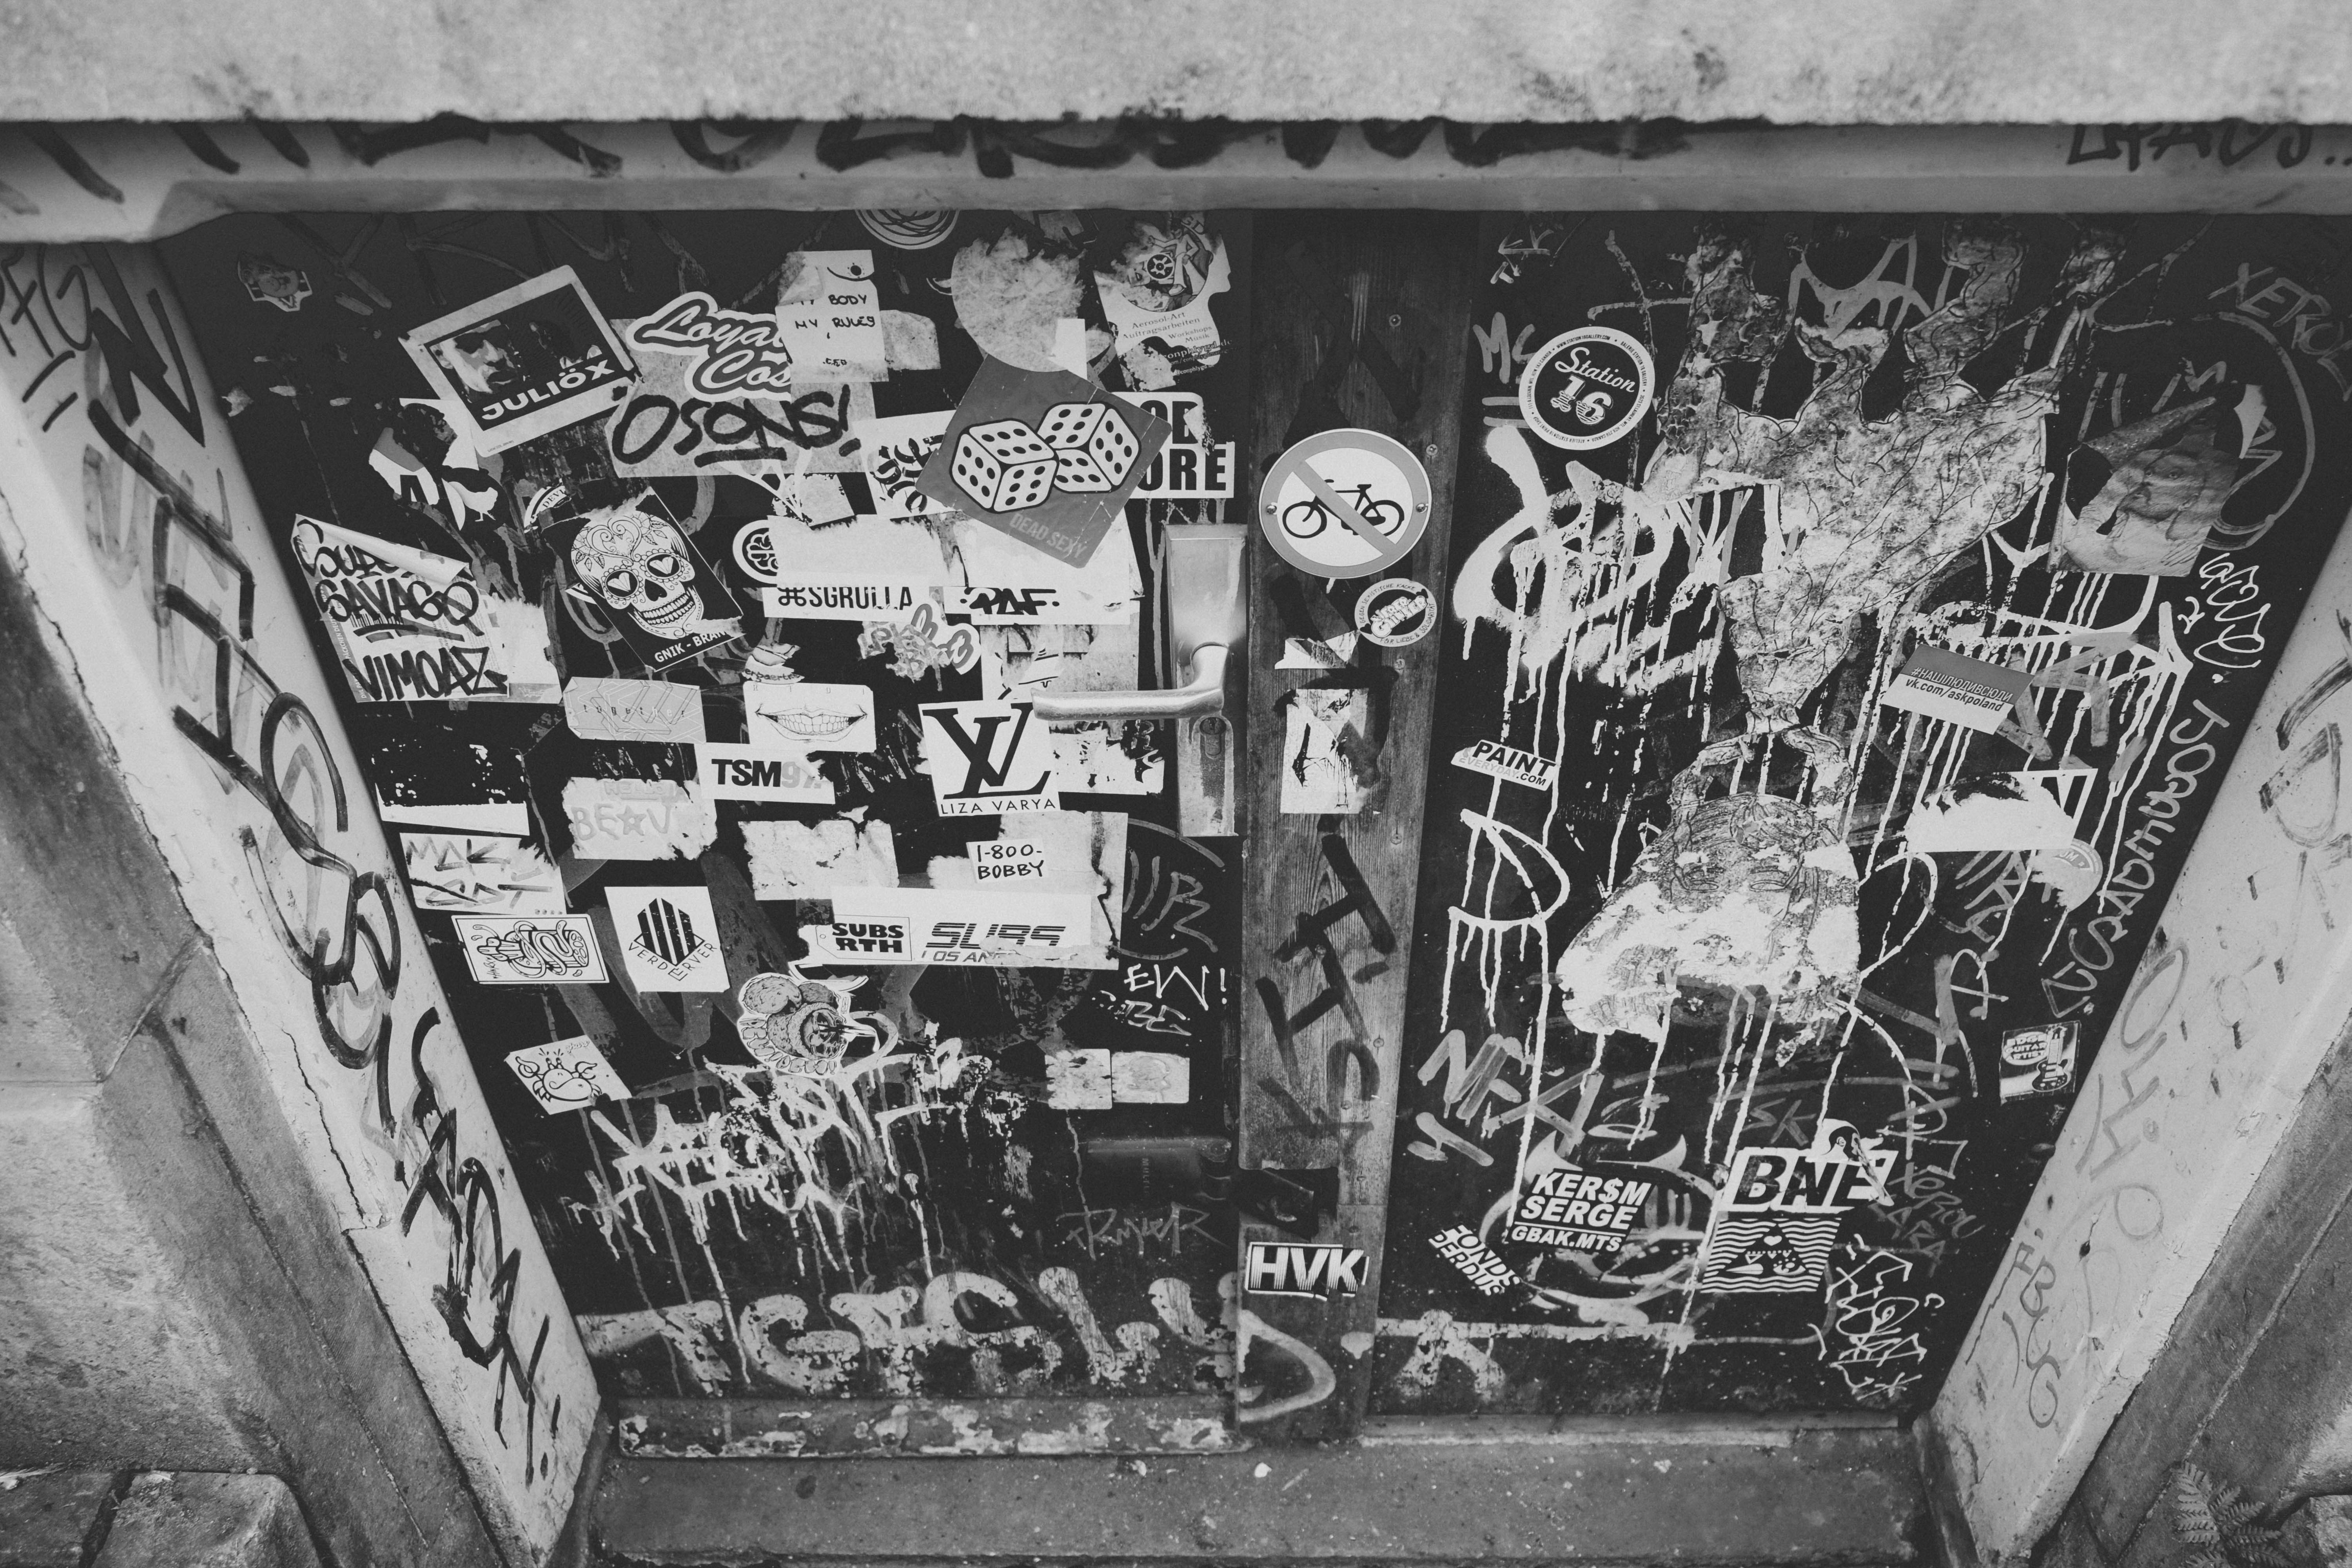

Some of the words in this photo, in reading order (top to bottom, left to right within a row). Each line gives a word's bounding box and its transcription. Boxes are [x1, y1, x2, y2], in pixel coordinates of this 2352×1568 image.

[828, 294, 867, 305] BODY
[795, 319, 818, 329] MY
[832, 316, 875, 328] RULES
[1123, 318, 1200, 339] Auftragsarbeiten
[1132, 312, 1185, 329] Aerosol-Art
[1169, 326, 1213, 339] Workshops
[1185, 333, 1210, 343] Musik
[1555, 347, 1635, 392] Station
[482, 358, 615, 420] JULIÖX
[1550, 374, 1614, 425] 16
[1009, 512, 1050, 541] DEAD
[1047, 531, 1088, 559] SEXY
[1362, 583, 1394, 604] SEXISTISCHE
[1396, 583, 1416, 591] KACKE
[1419, 603, 1436, 633] SOLIDARITÄT
[654, 643, 686, 663] GNIK
[691, 629, 728, 647] BRAN
[1906, 678, 2005, 712] vk.com/askpoland
[1472, 741, 1557, 777] PAINT
[941, 801, 983, 815] LIZA
[991, 798, 1056, 812] VARYA
[978, 860, 1044, 880] BOBBY
[832, 922, 904, 938] SUBS
[836, 937, 903, 953] RTH
[2005, 1042, 2048, 1053] GUITAR
[2006, 1033, 2047, 1047] EDGE
[2004, 1050, 2046, 1061] ARTIST
[1520, 1196, 1639, 1230] SERGE
[1511, 1226, 1623, 1253] GBAK.MTS
[1250, 1246, 1364, 1295] HVK
